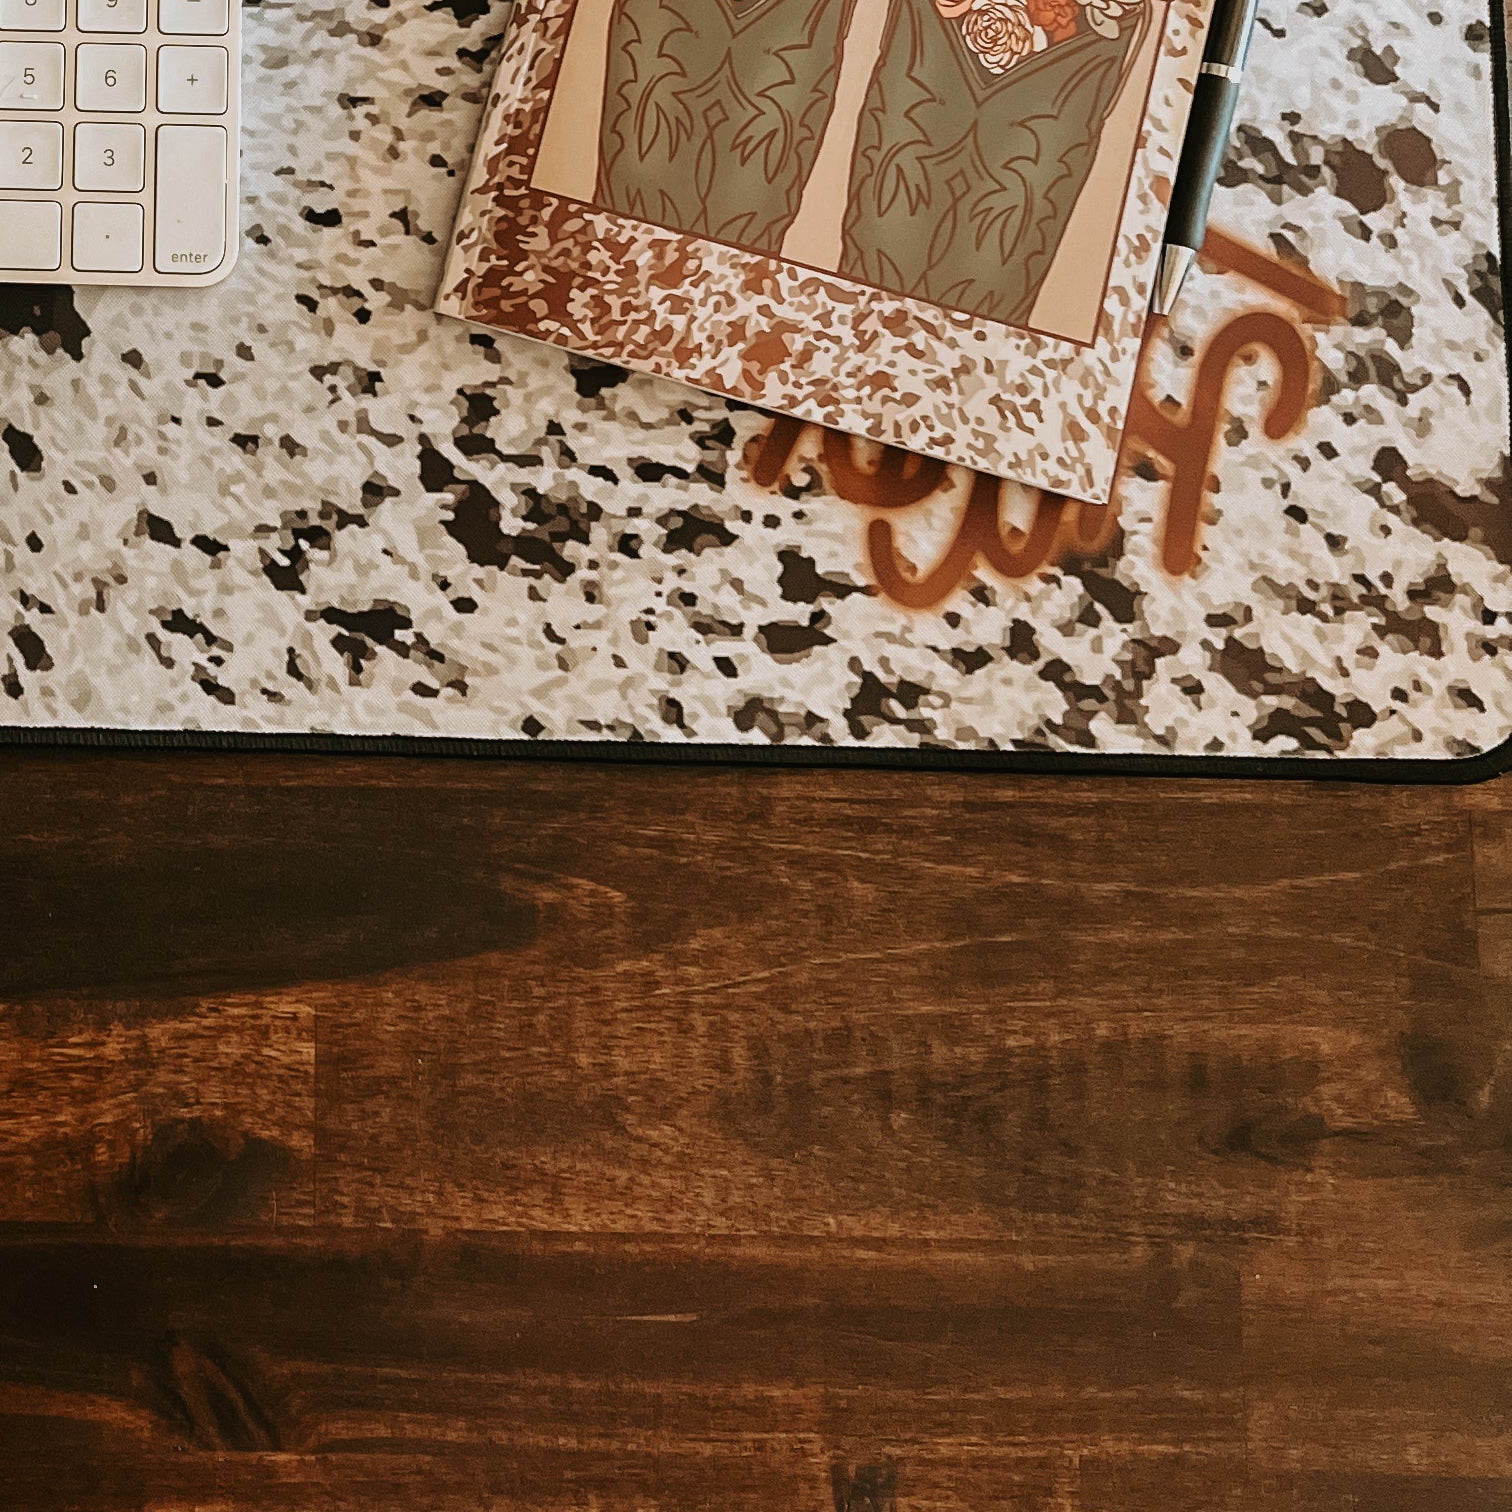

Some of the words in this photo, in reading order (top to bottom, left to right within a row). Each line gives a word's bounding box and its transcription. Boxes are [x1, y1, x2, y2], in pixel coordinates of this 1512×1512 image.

[23, 67, 36, 86] 5
[104, 69, 117, 88] 6
[21, 146, 34, 165] 2
[102, 148, 115, 167] 3
[171, 251, 209, 264] enter
